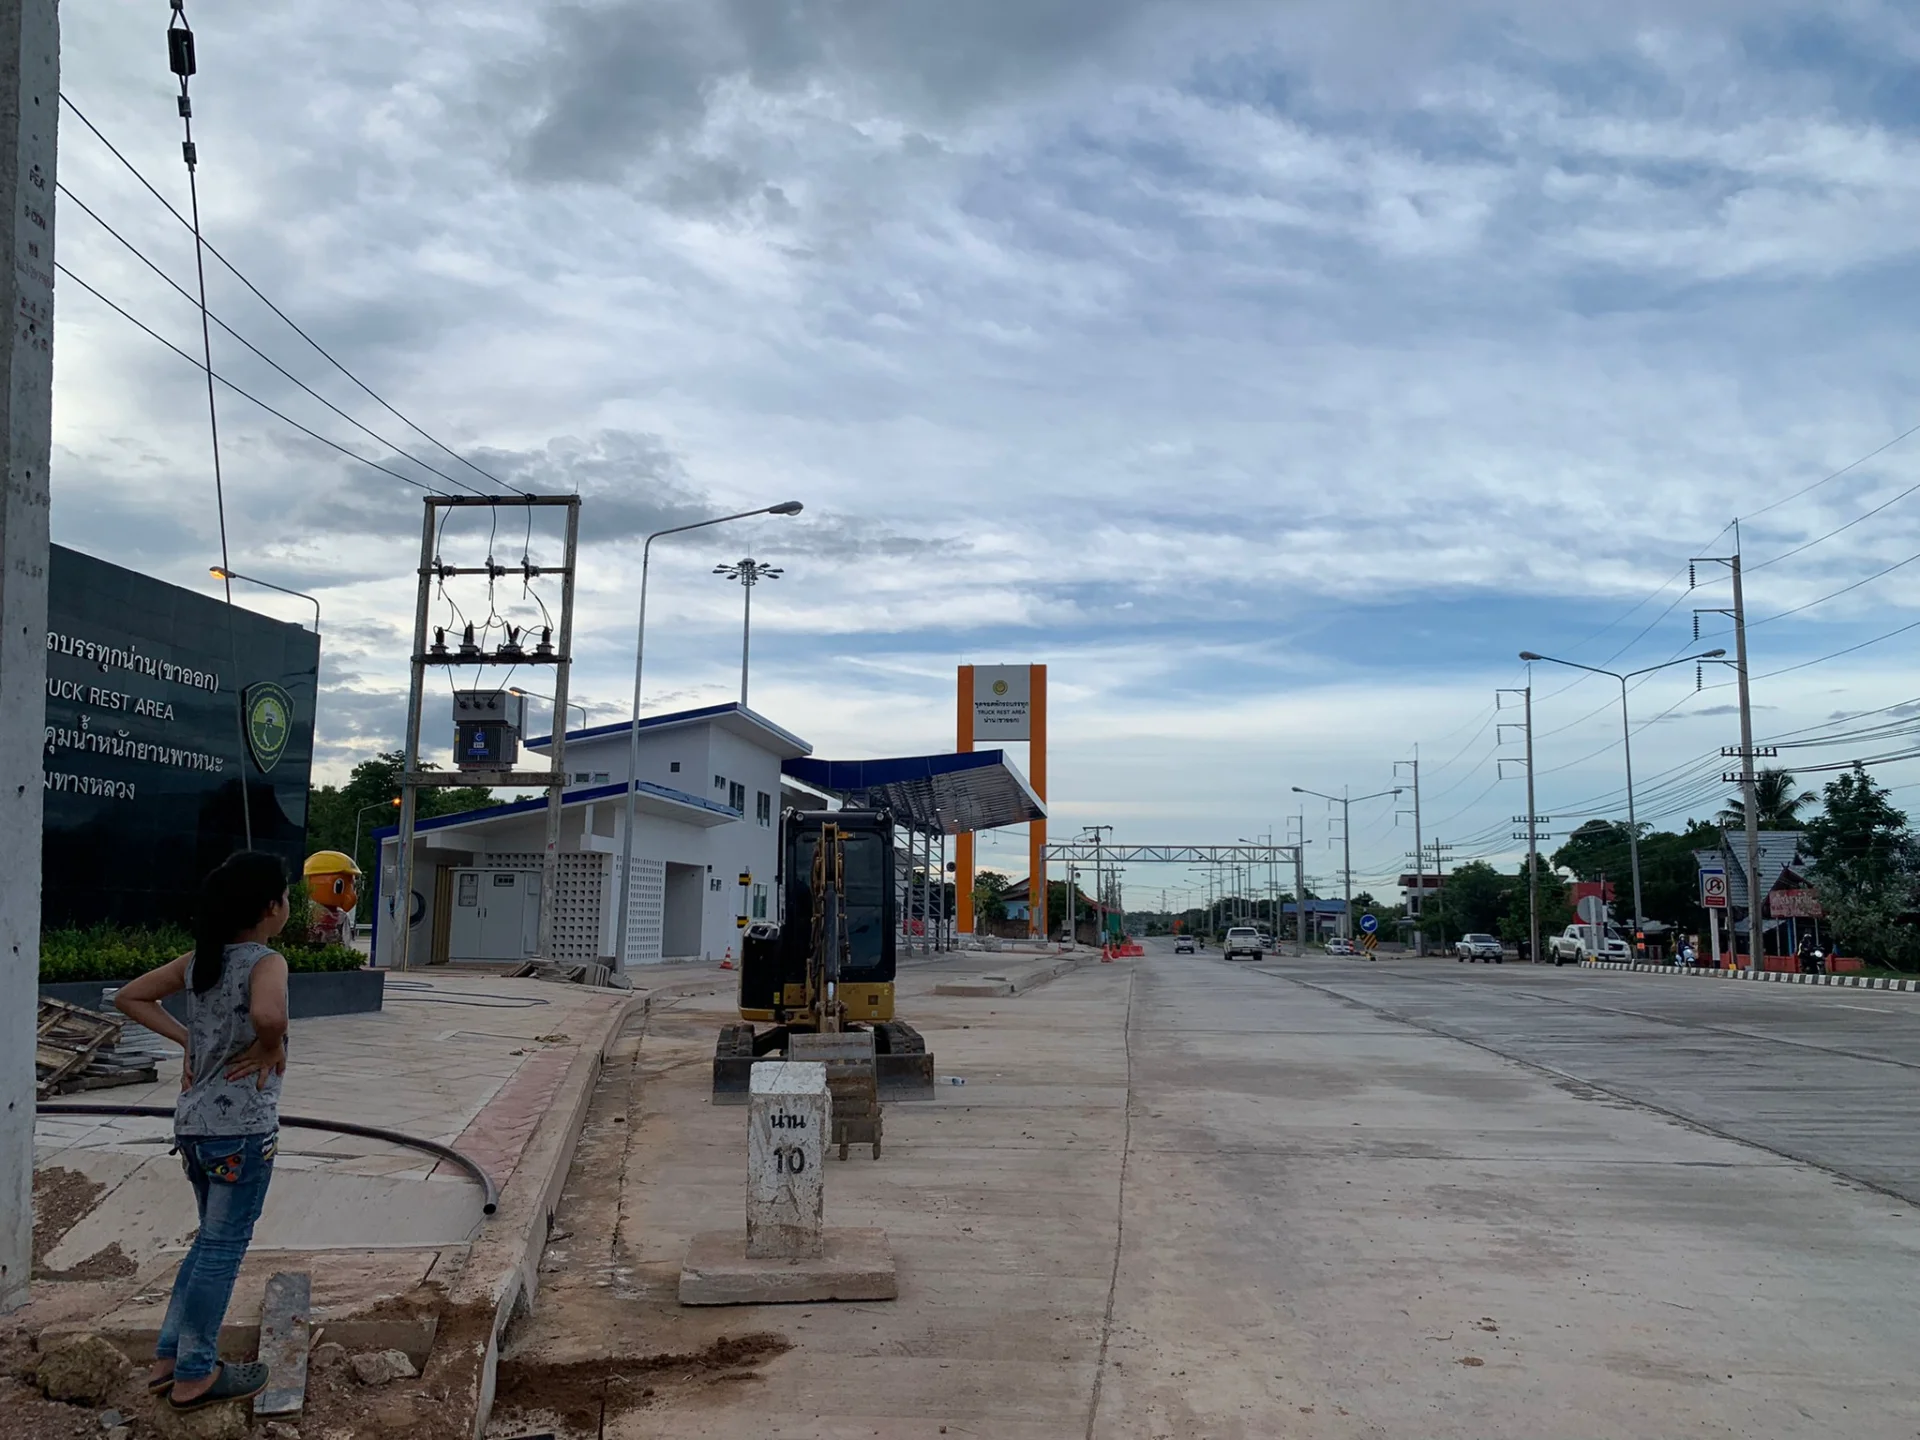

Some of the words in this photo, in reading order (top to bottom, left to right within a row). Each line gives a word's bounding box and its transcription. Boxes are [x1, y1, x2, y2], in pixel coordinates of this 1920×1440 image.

[45, 677, 84, 702] UCK
[89, 687, 131, 711] REST
[134, 698, 175, 721] AREA
[770, 1108, 807, 1129] น่าน
[773, 1146, 805, 1175] 10
